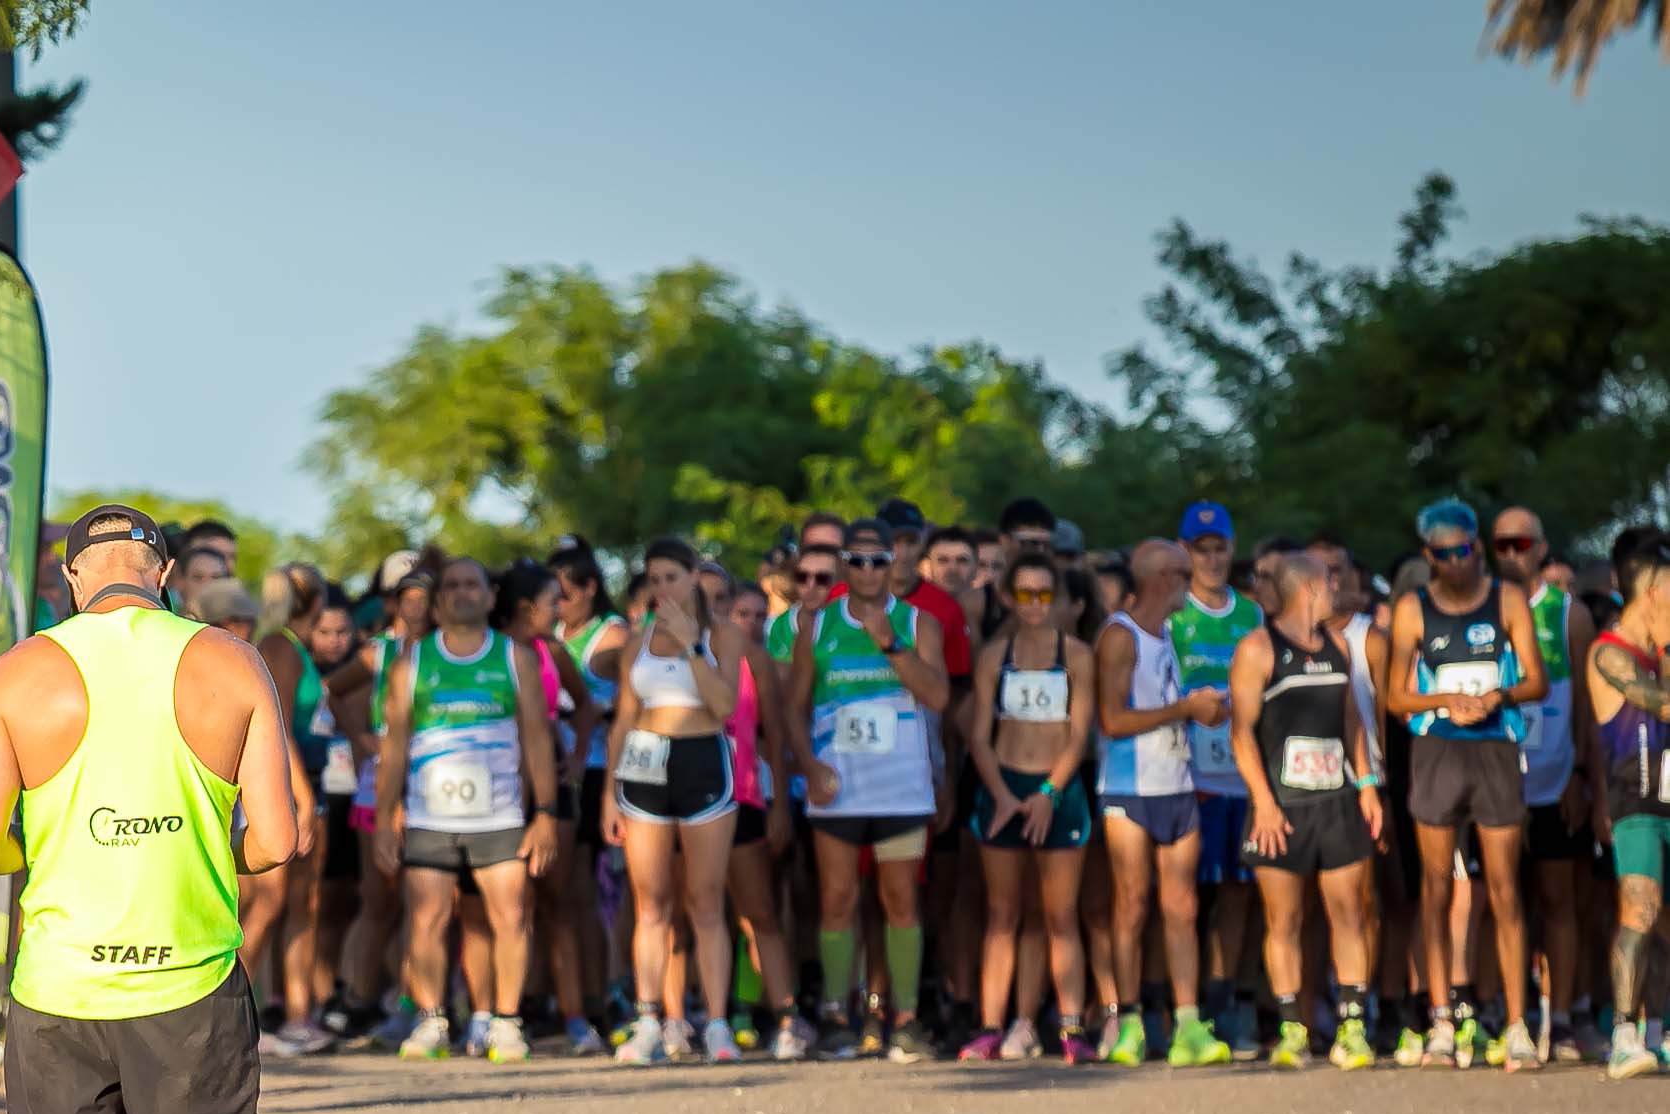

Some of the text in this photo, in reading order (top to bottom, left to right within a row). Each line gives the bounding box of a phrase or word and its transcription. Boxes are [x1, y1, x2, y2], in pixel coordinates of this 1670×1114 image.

[849, 717, 882, 744] 51
[441, 778, 476, 804] 90
[90, 807, 183, 846] CRONO
[111, 838, 140, 848] RAV
[91, 945, 173, 965] STAFF
